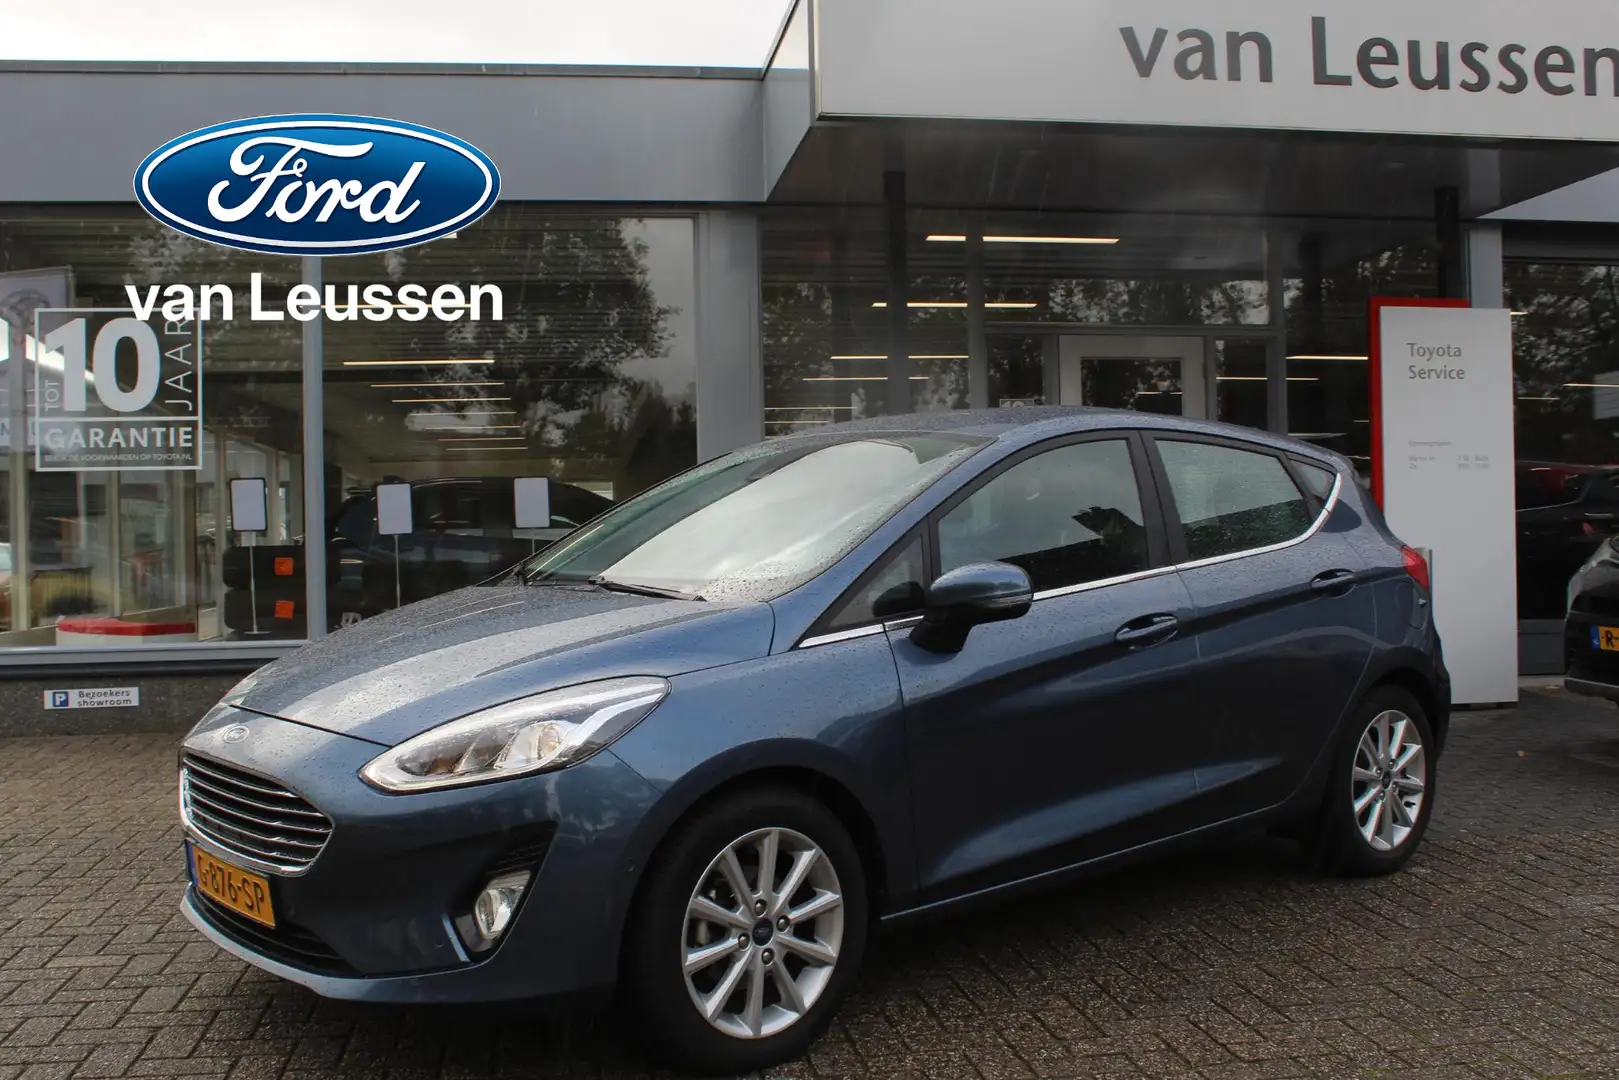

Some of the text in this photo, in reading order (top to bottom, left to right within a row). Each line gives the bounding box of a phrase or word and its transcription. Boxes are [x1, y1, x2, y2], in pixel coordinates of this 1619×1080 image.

[1118, 16, 1619, 98] van Leussen
[1407, 342, 1462, 362] Toyota
[44, 317, 161, 413] 10
[164, 319, 193, 411] JAAR
[1408, 365, 1466, 380] Service
[44, 379, 60, 412] TOT
[44, 427, 193, 449] GARANTIE
[77, 698, 132, 707] showroom
[78, 690, 130, 699] Bezoekers
